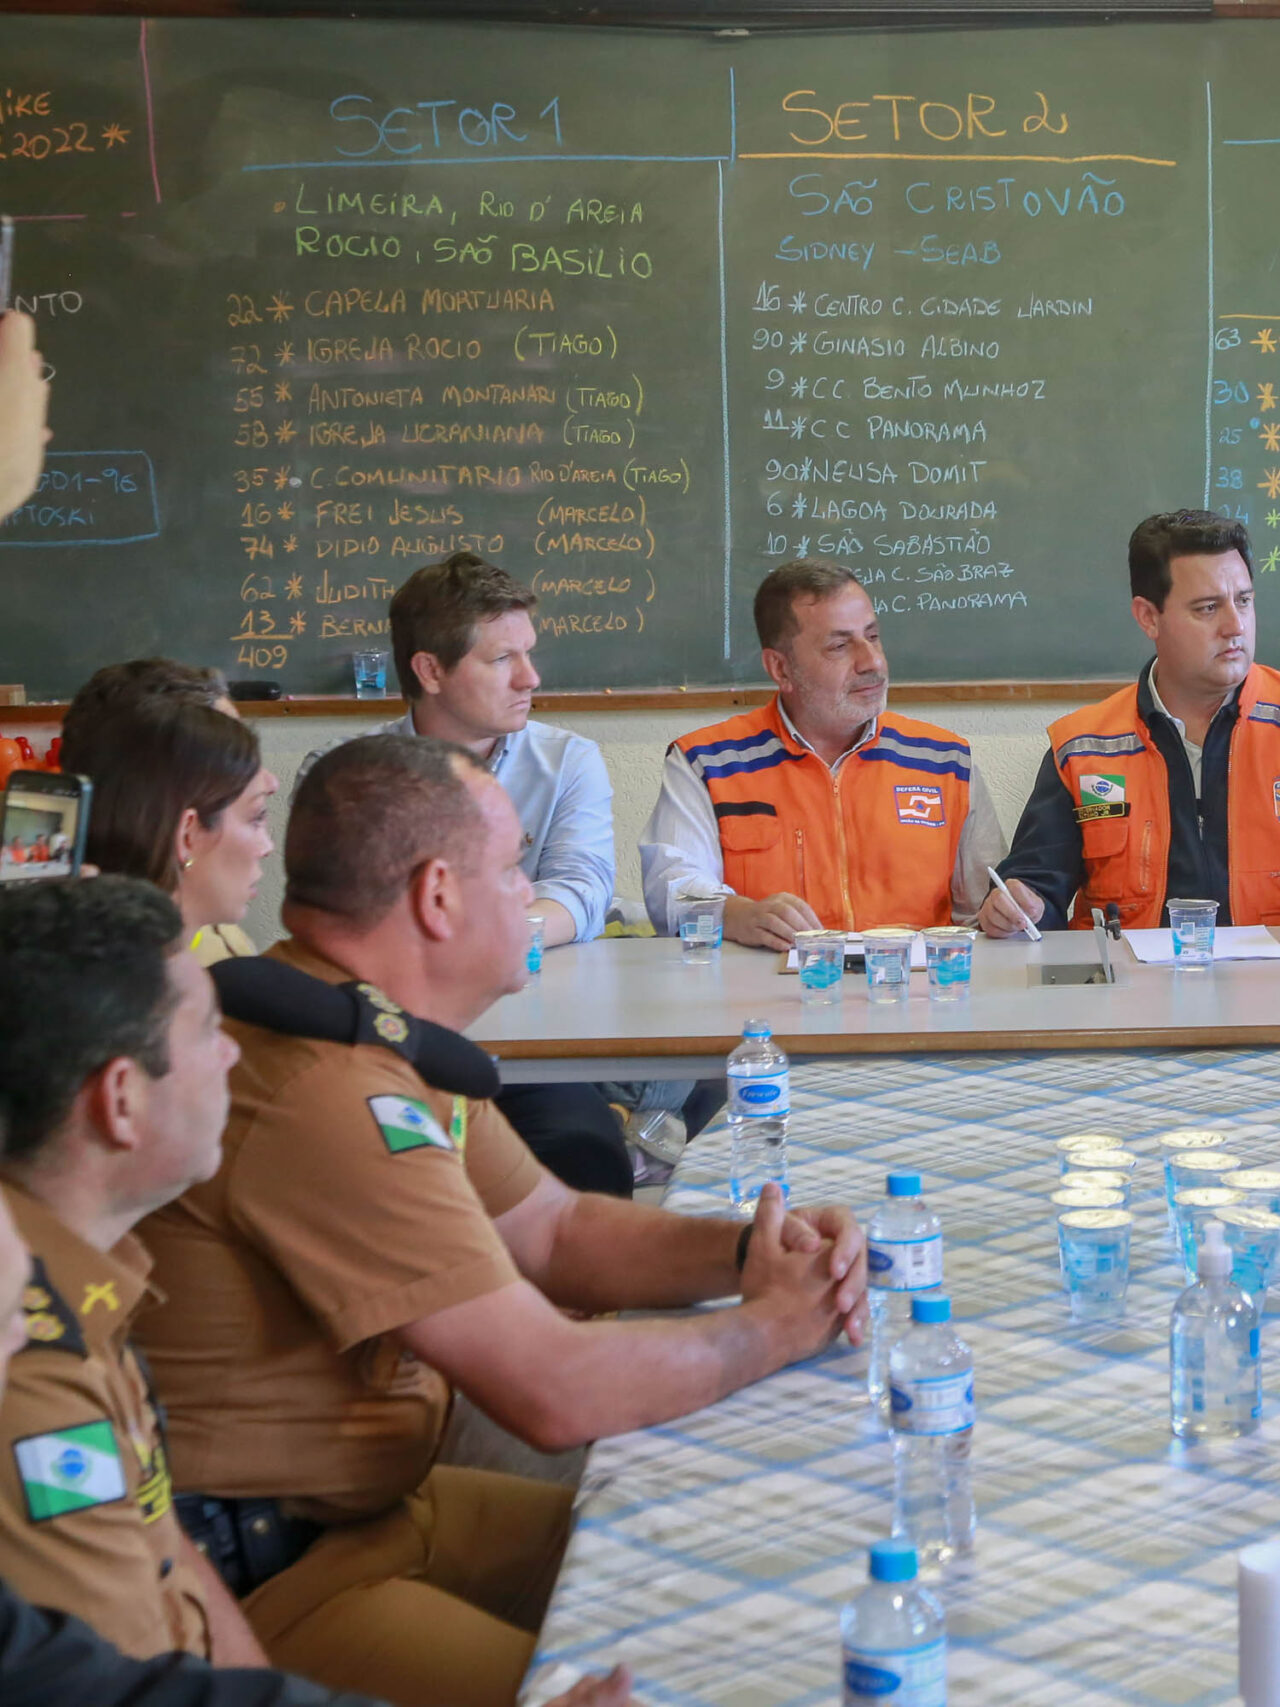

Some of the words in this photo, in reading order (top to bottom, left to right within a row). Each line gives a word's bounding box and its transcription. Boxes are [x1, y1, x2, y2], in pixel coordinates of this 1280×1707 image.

[329, 94, 527, 156] SETOR
[540, 96, 562, 147] 1
[782, 89, 1007, 145] SETOR
[1023, 91, 1068, 135] 2
[12, 122, 95, 159] 2022
[480, 190, 514, 218] RIO
[566, 197, 643, 224] AREIA
[906, 172, 1125, 218] CRISTOVÃO
[511, 243, 652, 278] BASILIO
[775, 236, 875, 271] SIDNEY
[227, 294, 263, 326] 22
[305, 289, 406, 318] CAPELA
[421, 289, 555, 313] MORTUARIA
[814, 293, 882, 319] CENTRO
[921, 297, 1001, 316] CIDADE
[307, 337, 393, 363] IGREJA
[408, 338, 481, 360] ROCIO
[752, 328, 783, 350] 90
[814, 331, 905, 359] GINASIO
[921, 334, 999, 359] ALBINO
[1214, 328, 1242, 351] 63
[233, 386, 264, 412] 55
[306, 382, 424, 416] ANTONIETA
[442, 383, 556, 407] MONTANARI
[766, 368, 785, 390] 9
[863, 376, 932, 400] BENTO
[944, 379, 1046, 401] MUNHOZ
[1213, 380, 1249, 404] 30
[310, 420, 386, 448] IGREJA
[402, 423, 544, 445] UCRANIANA
[868, 416, 988, 444] PANORAMA
[1219, 427, 1243, 444] 25
[234, 468, 269, 492] 35
[336, 464, 521, 488] COMUNITARIO
[530, 463, 554, 483] RIO
[766, 459, 799, 482] 90
[909, 461, 988, 484] DOMIT
[1216, 466, 1244, 489] 38
[241, 503, 272, 528] 16
[316, 500, 372, 527] FREI
[388, 498, 465, 527] JESUS
[766, 491, 782, 516] 6
[811, 501, 887, 521] LAGOA
[899, 501, 998, 520] DOURADA
[317, 534, 380, 558] DIDIO
[763, 531, 787, 555] 10
[241, 573, 276, 602] 62
[917, 591, 1028, 611] PANORAMA
[241, 610, 276, 637] 13
[238, 645, 288, 669] 409
